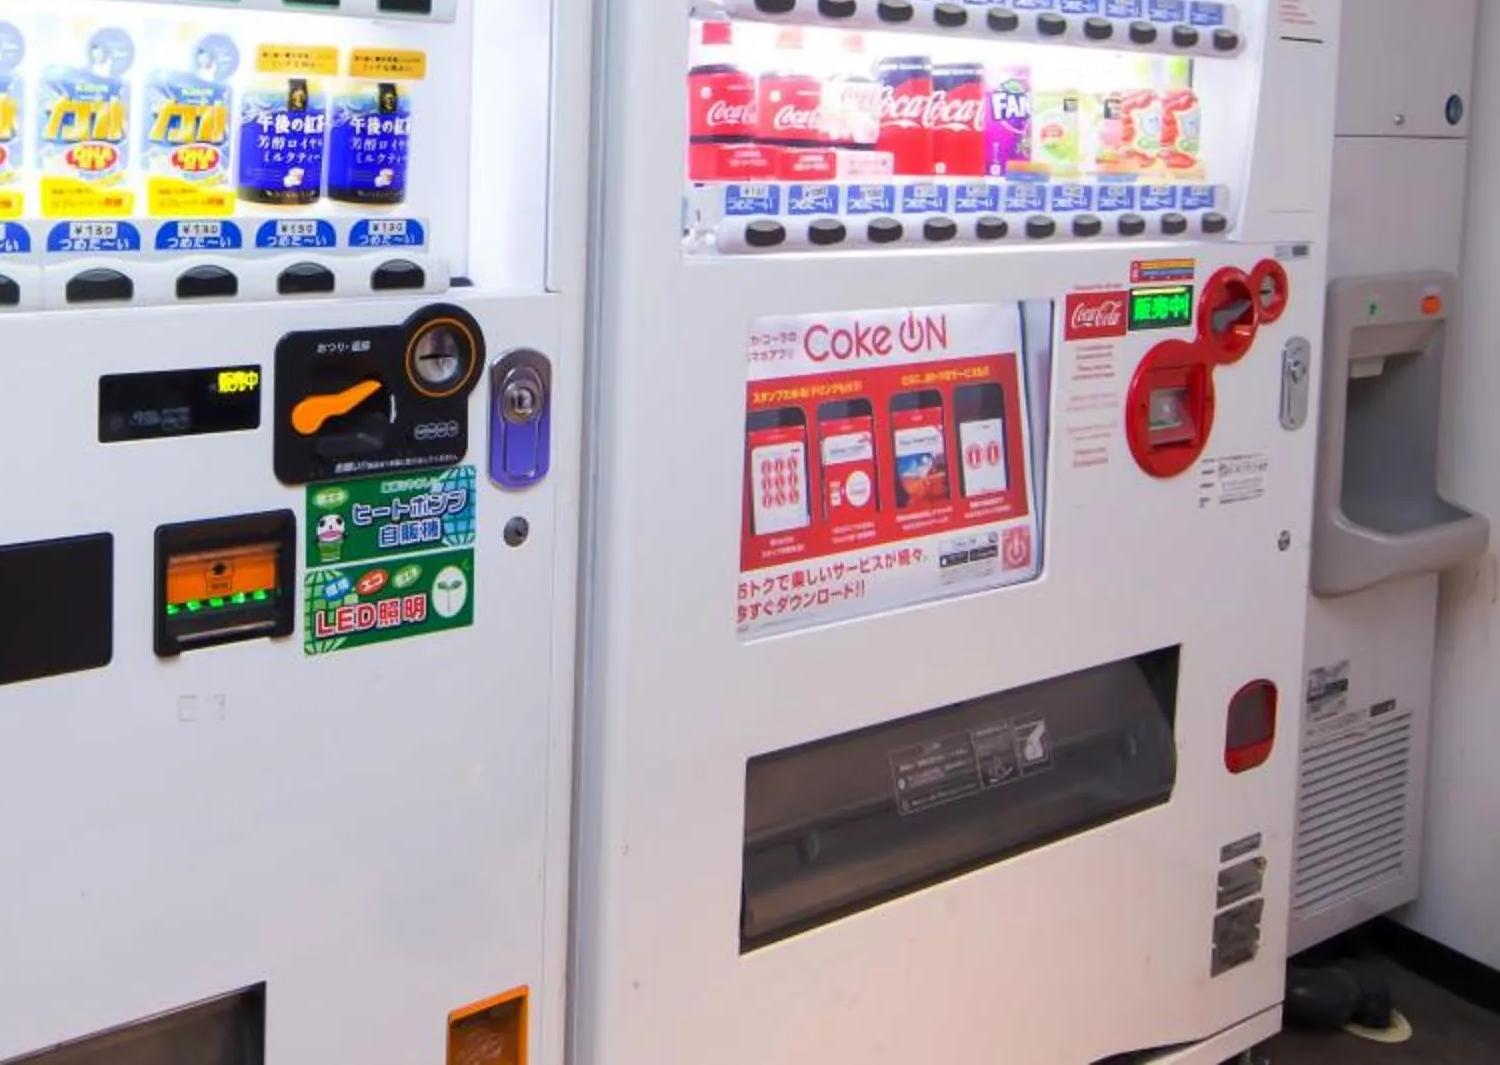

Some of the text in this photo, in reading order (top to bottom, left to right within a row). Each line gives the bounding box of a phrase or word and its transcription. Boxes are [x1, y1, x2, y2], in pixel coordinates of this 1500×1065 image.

[74, 223, 114, 236] ¥130
[803, 321, 893, 362] Coke
[352, 488, 468, 526] ヒートポンプ
[378, 517, 442, 549] 自販機
[315, 593, 428, 638] LED照明
